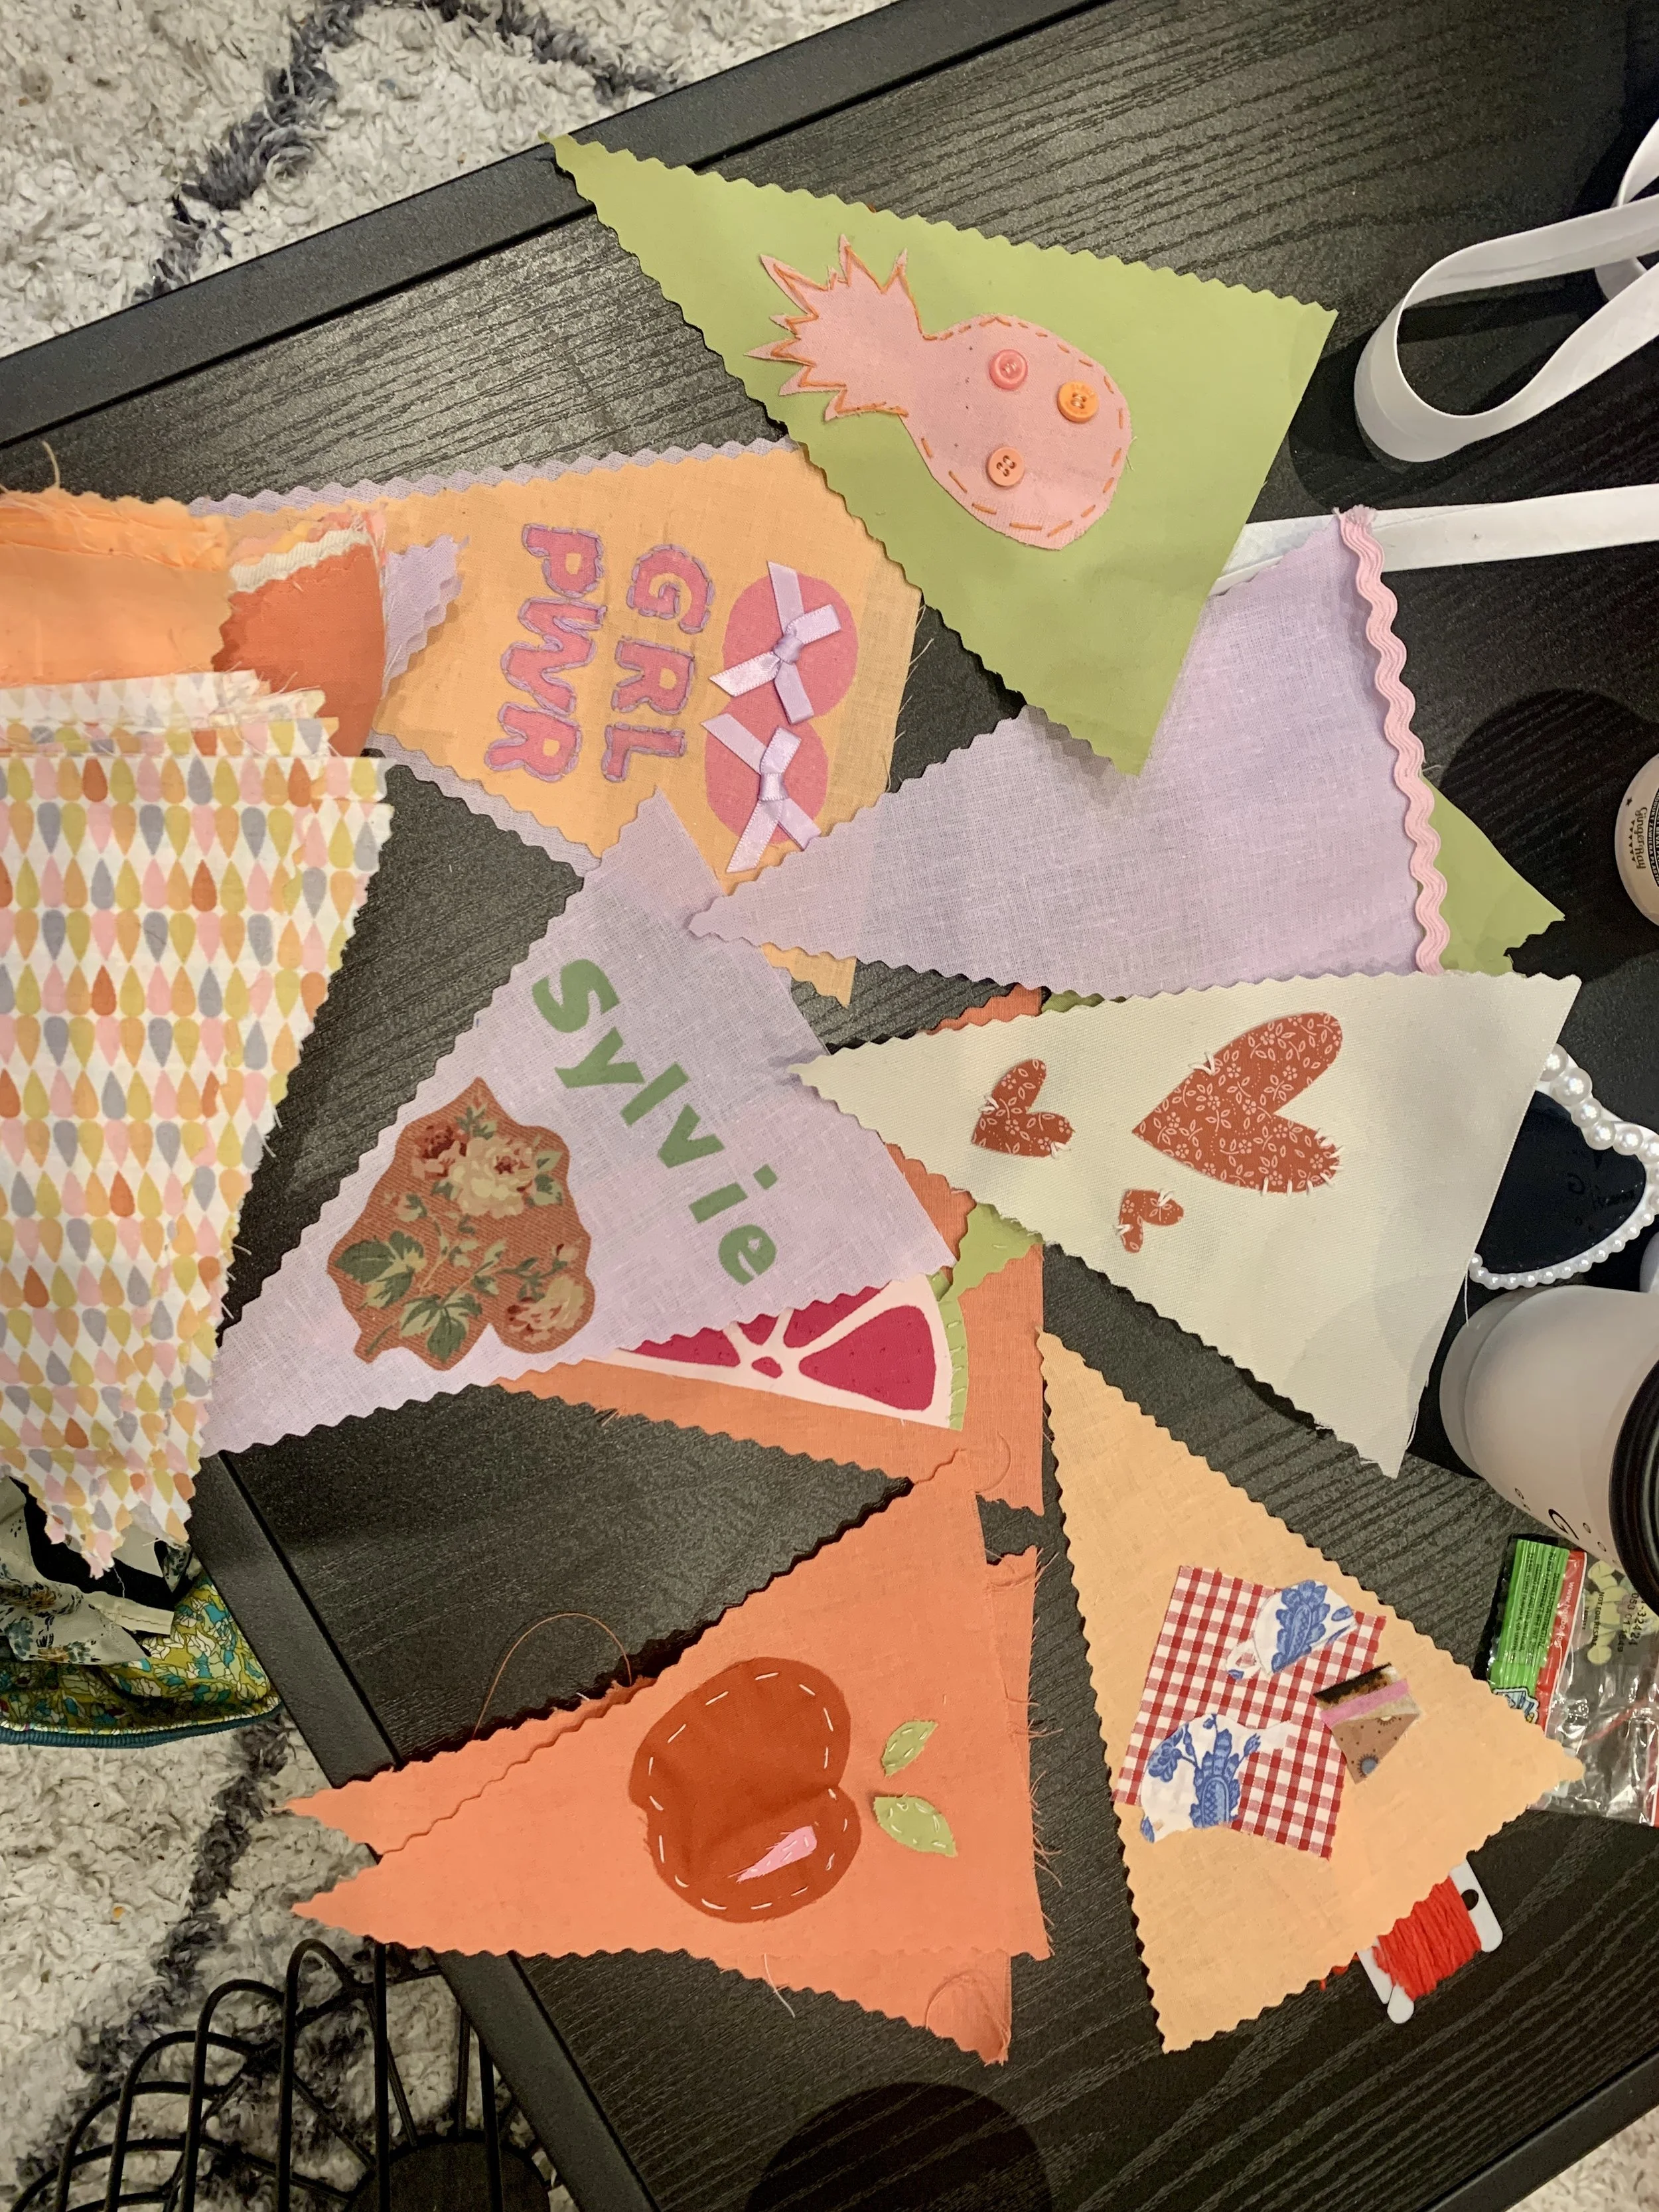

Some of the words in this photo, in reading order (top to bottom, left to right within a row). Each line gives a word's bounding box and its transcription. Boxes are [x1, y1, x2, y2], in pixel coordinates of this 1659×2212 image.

[484, 523, 608, 783] PWR
[601, 544, 716, 782] GRL
[1634, 806, 1648, 846] Ginger
[1634, 845, 1646, 869] Ray
[530, 958, 779, 1286] Sylvie
[1627, 1593, 1639, 1610] 053
